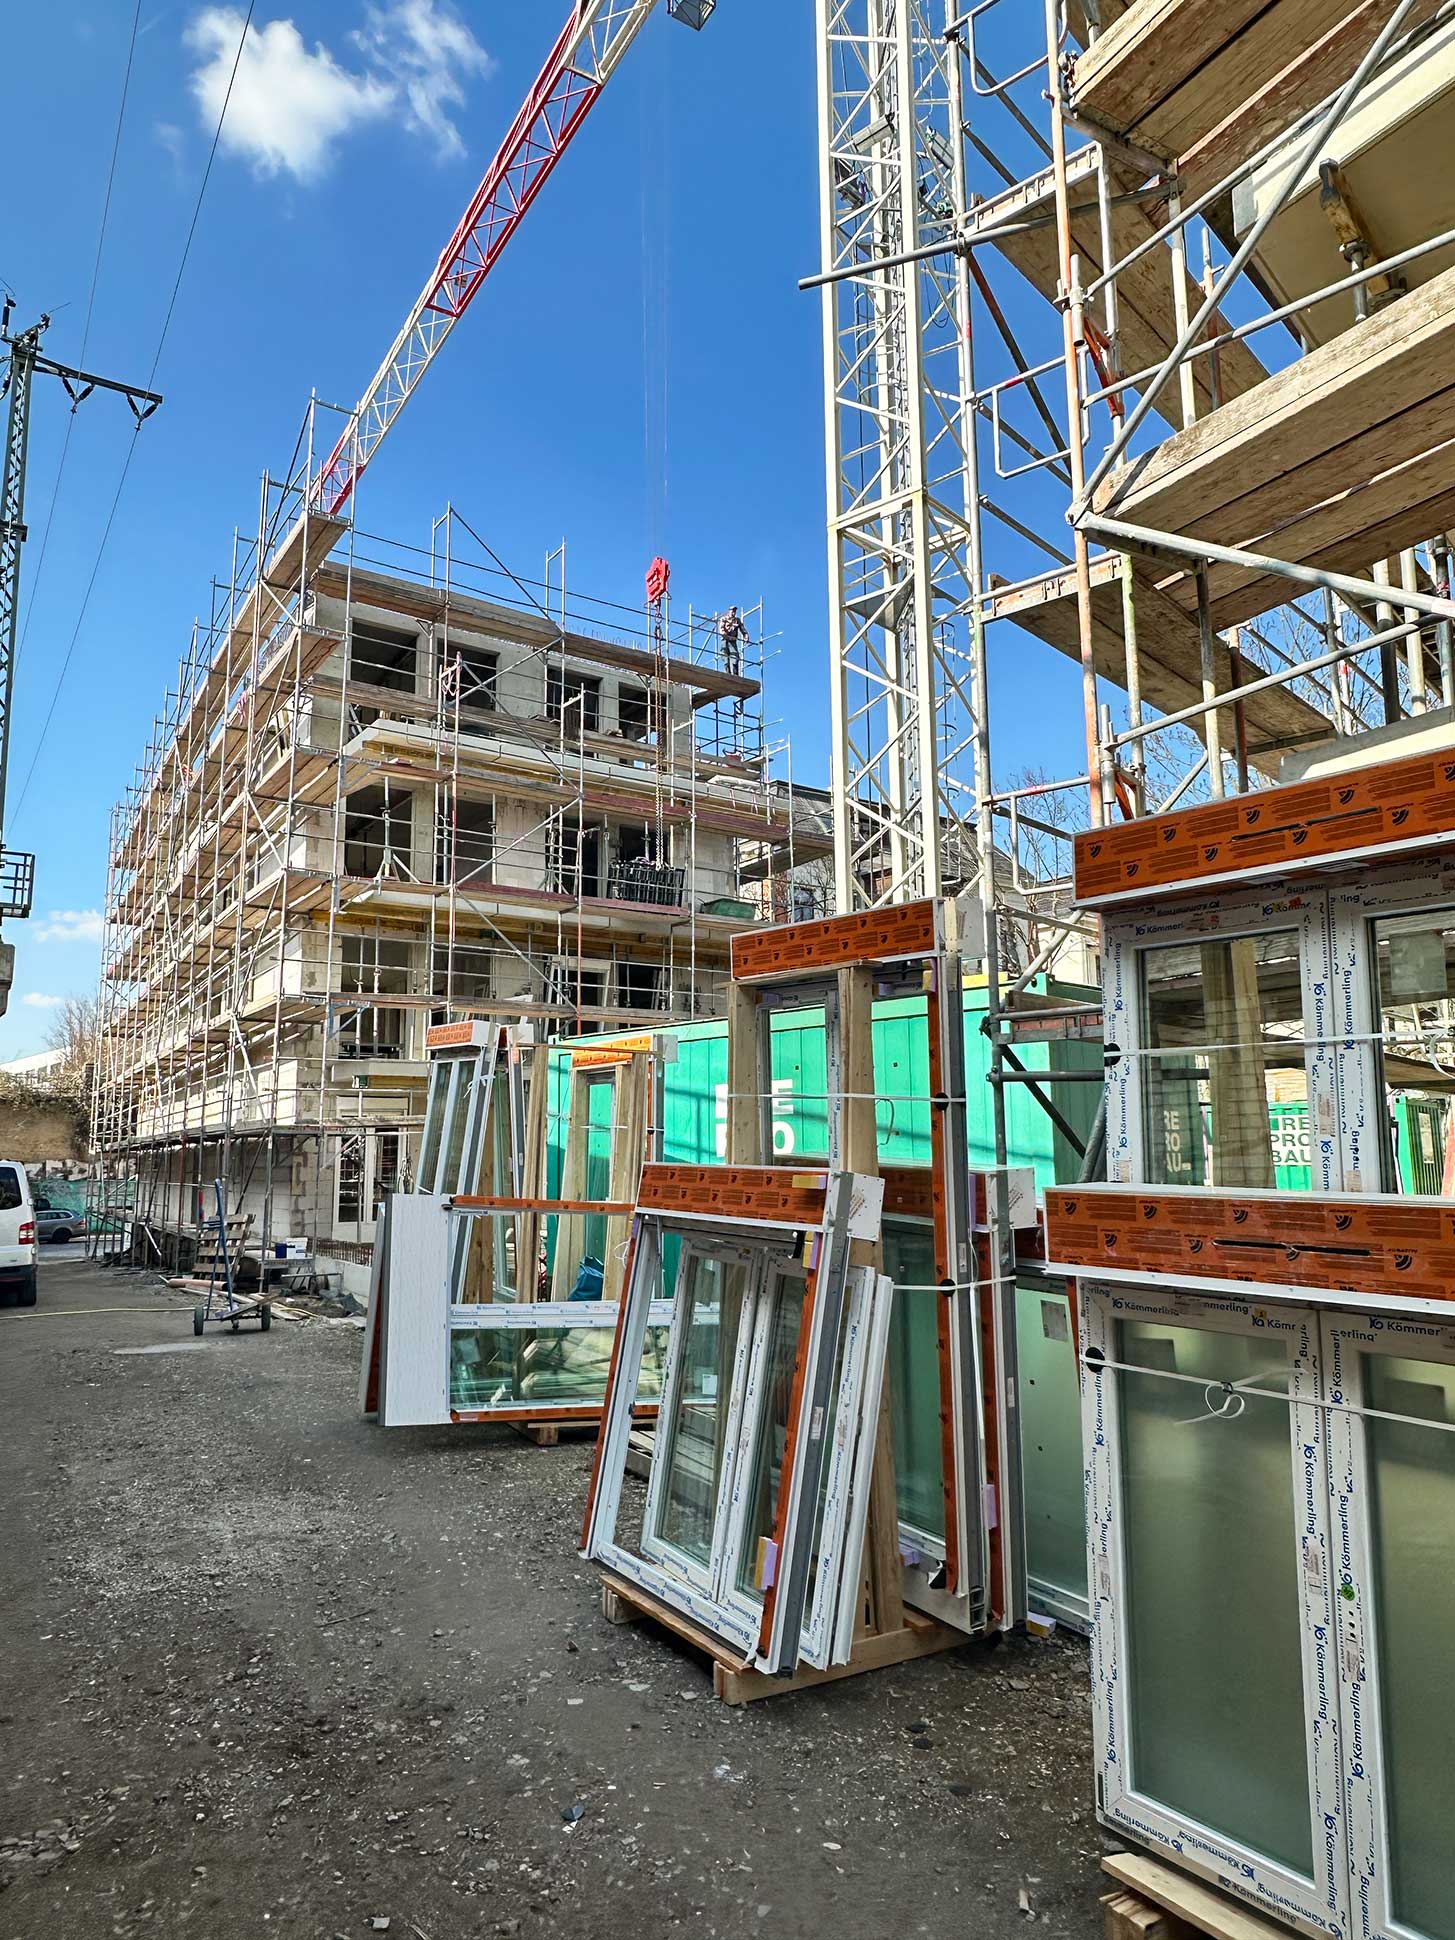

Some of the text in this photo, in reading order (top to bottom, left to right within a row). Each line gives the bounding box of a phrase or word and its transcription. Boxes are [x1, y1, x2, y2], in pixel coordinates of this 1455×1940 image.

[1342, 970, 1353, 1035] Kömmerling
[1120, 1078, 1128, 1136] Kömmerling
[1304, 1461, 1317, 1535] Kömmerling
[1338, 1494, 1352, 1572] Kömmerling
[1106, 1680, 1115, 1748] Kömmerling
[1316, 1643, 1330, 1721] Kömmerling
[1350, 1682, 1364, 1760] Kömmerling
[1324, 1831, 1338, 1911] Kömmerling
